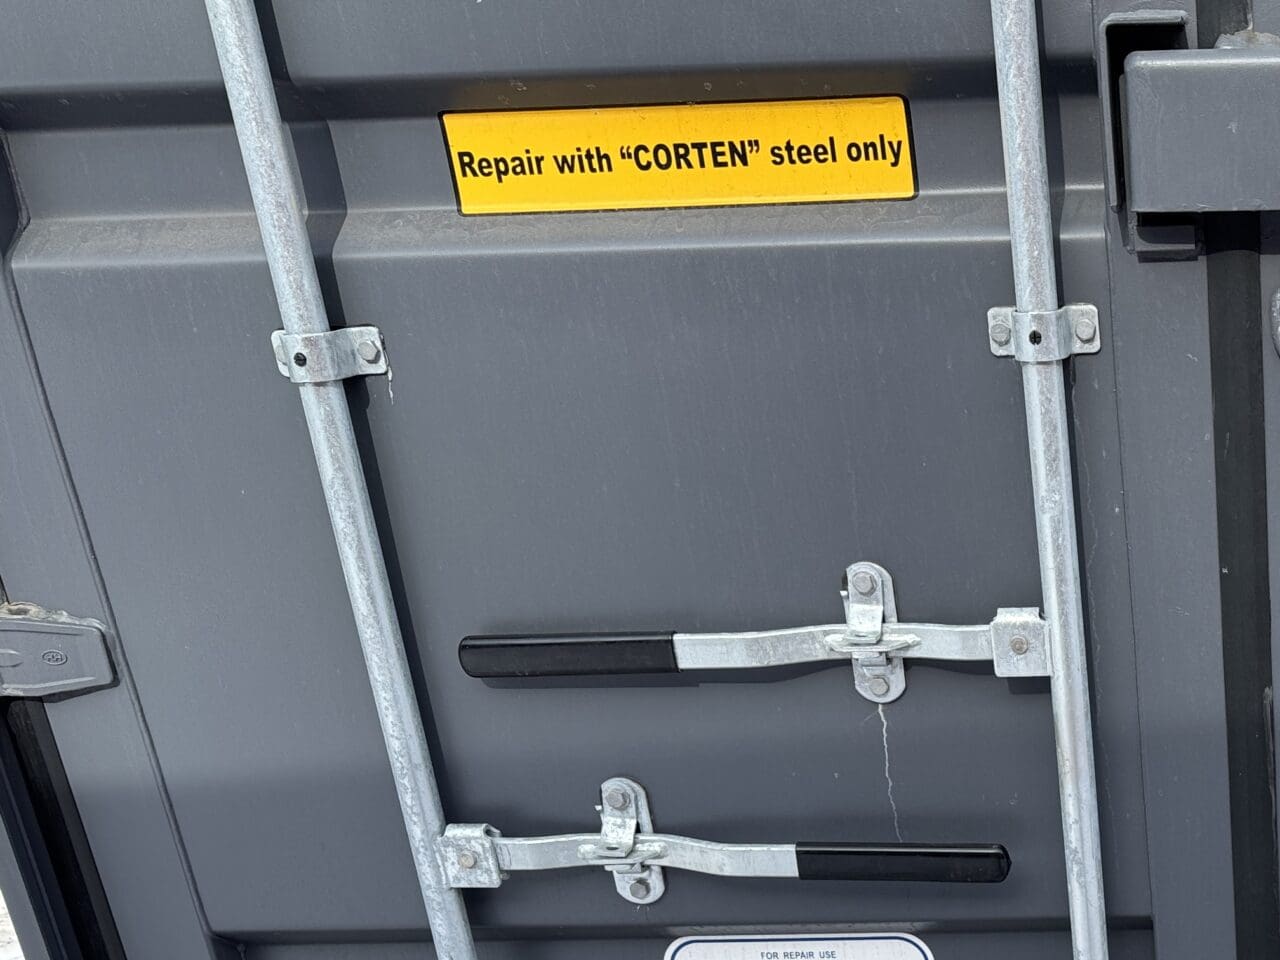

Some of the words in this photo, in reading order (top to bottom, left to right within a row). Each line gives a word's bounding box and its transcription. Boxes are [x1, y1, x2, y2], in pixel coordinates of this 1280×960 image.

[457, 148, 544, 183] Repair
[554, 147, 613, 175] with
[770, 136, 837, 166] steel
[849, 134, 902, 167] only
[760, 951, 779, 960] FOR
[783, 951, 815, 960] REPAIR
[819, 950, 837, 959] USE
